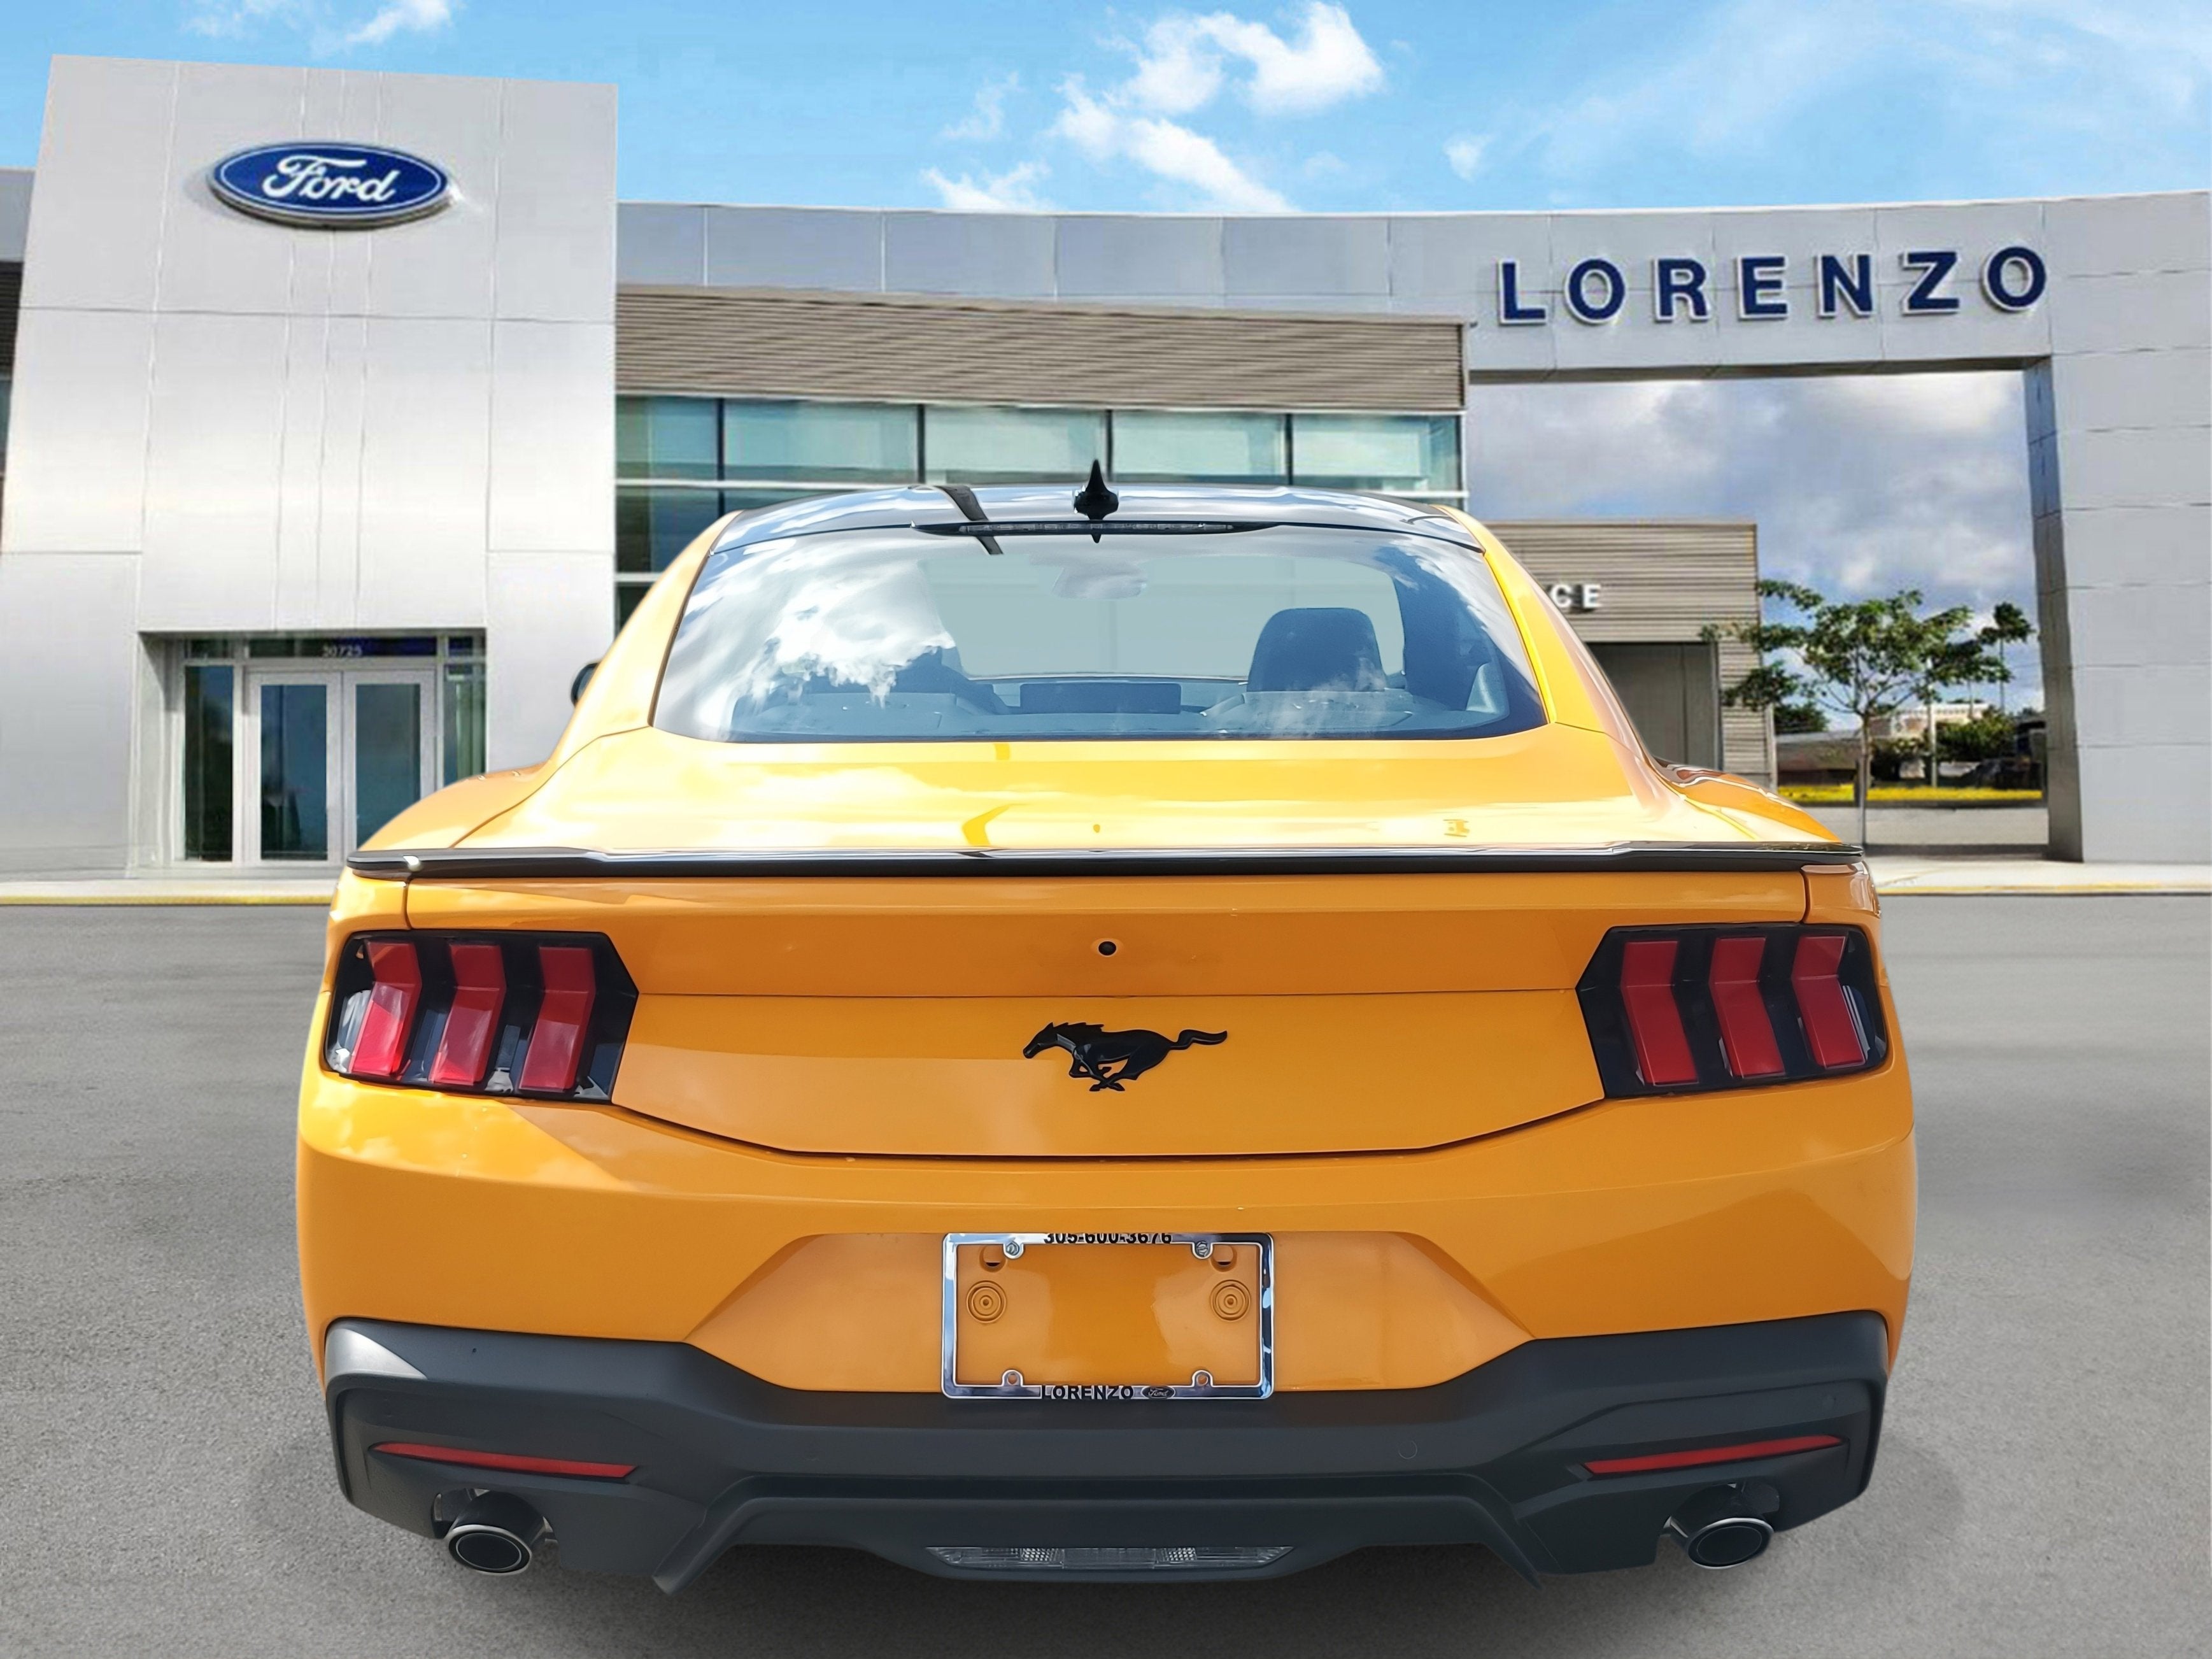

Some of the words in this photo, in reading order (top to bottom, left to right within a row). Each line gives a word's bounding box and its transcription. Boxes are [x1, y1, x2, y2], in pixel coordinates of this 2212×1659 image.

[262, 155, 401, 201] Ford
[1498, 246, 2046, 325] LORENZO
[1042, 1385, 1134, 1400] LORENZO
